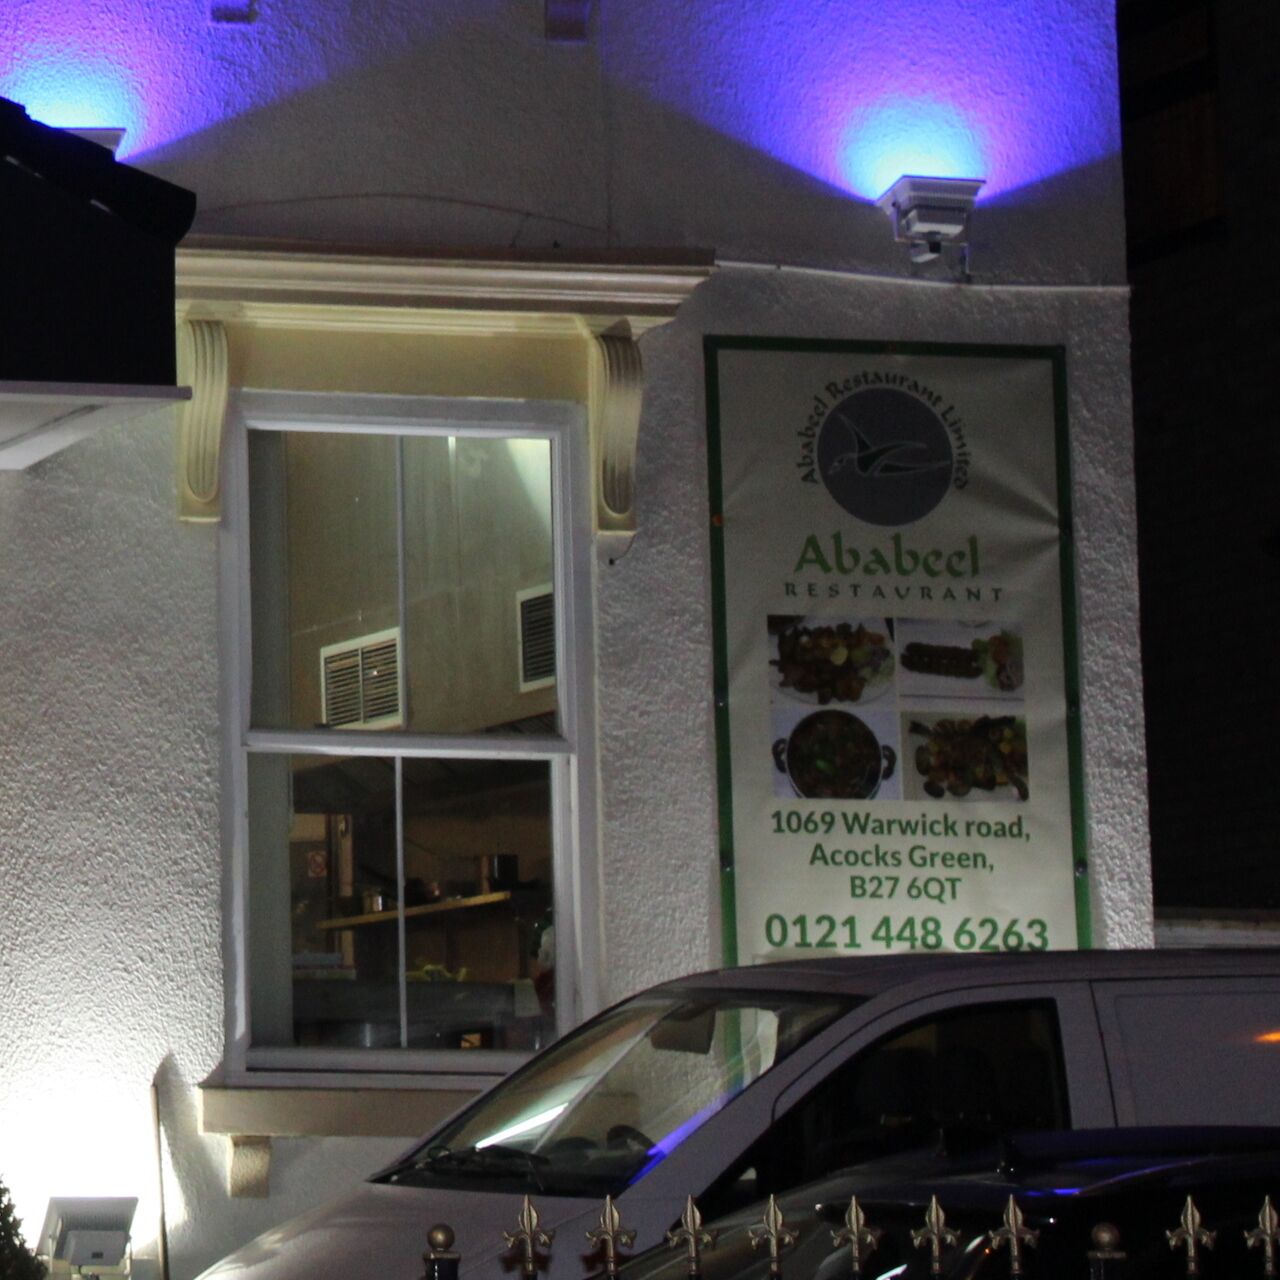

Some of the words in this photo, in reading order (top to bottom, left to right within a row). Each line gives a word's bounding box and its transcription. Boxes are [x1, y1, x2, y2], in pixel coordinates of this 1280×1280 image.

[796, 394, 829, 485] Ababeel
[824, 369, 943, 408] Restaurant
[794, 531, 980, 577] Ababeel
[784, 581, 1003, 603] RESTAURANT
[770, 809, 835, 834] 1069
[841, 811, 959, 837] Warwick
[965, 815, 1031, 842] road,
[809, 843, 902, 868] Acocks
[908, 845, 995, 872] Green,
[850, 876, 900, 900] B27
[906, 877, 963, 904] 6QT
[764, 913, 862, 950] 0121
[871, 916, 944, 951] 448
[953, 917, 1050, 952] 6263
